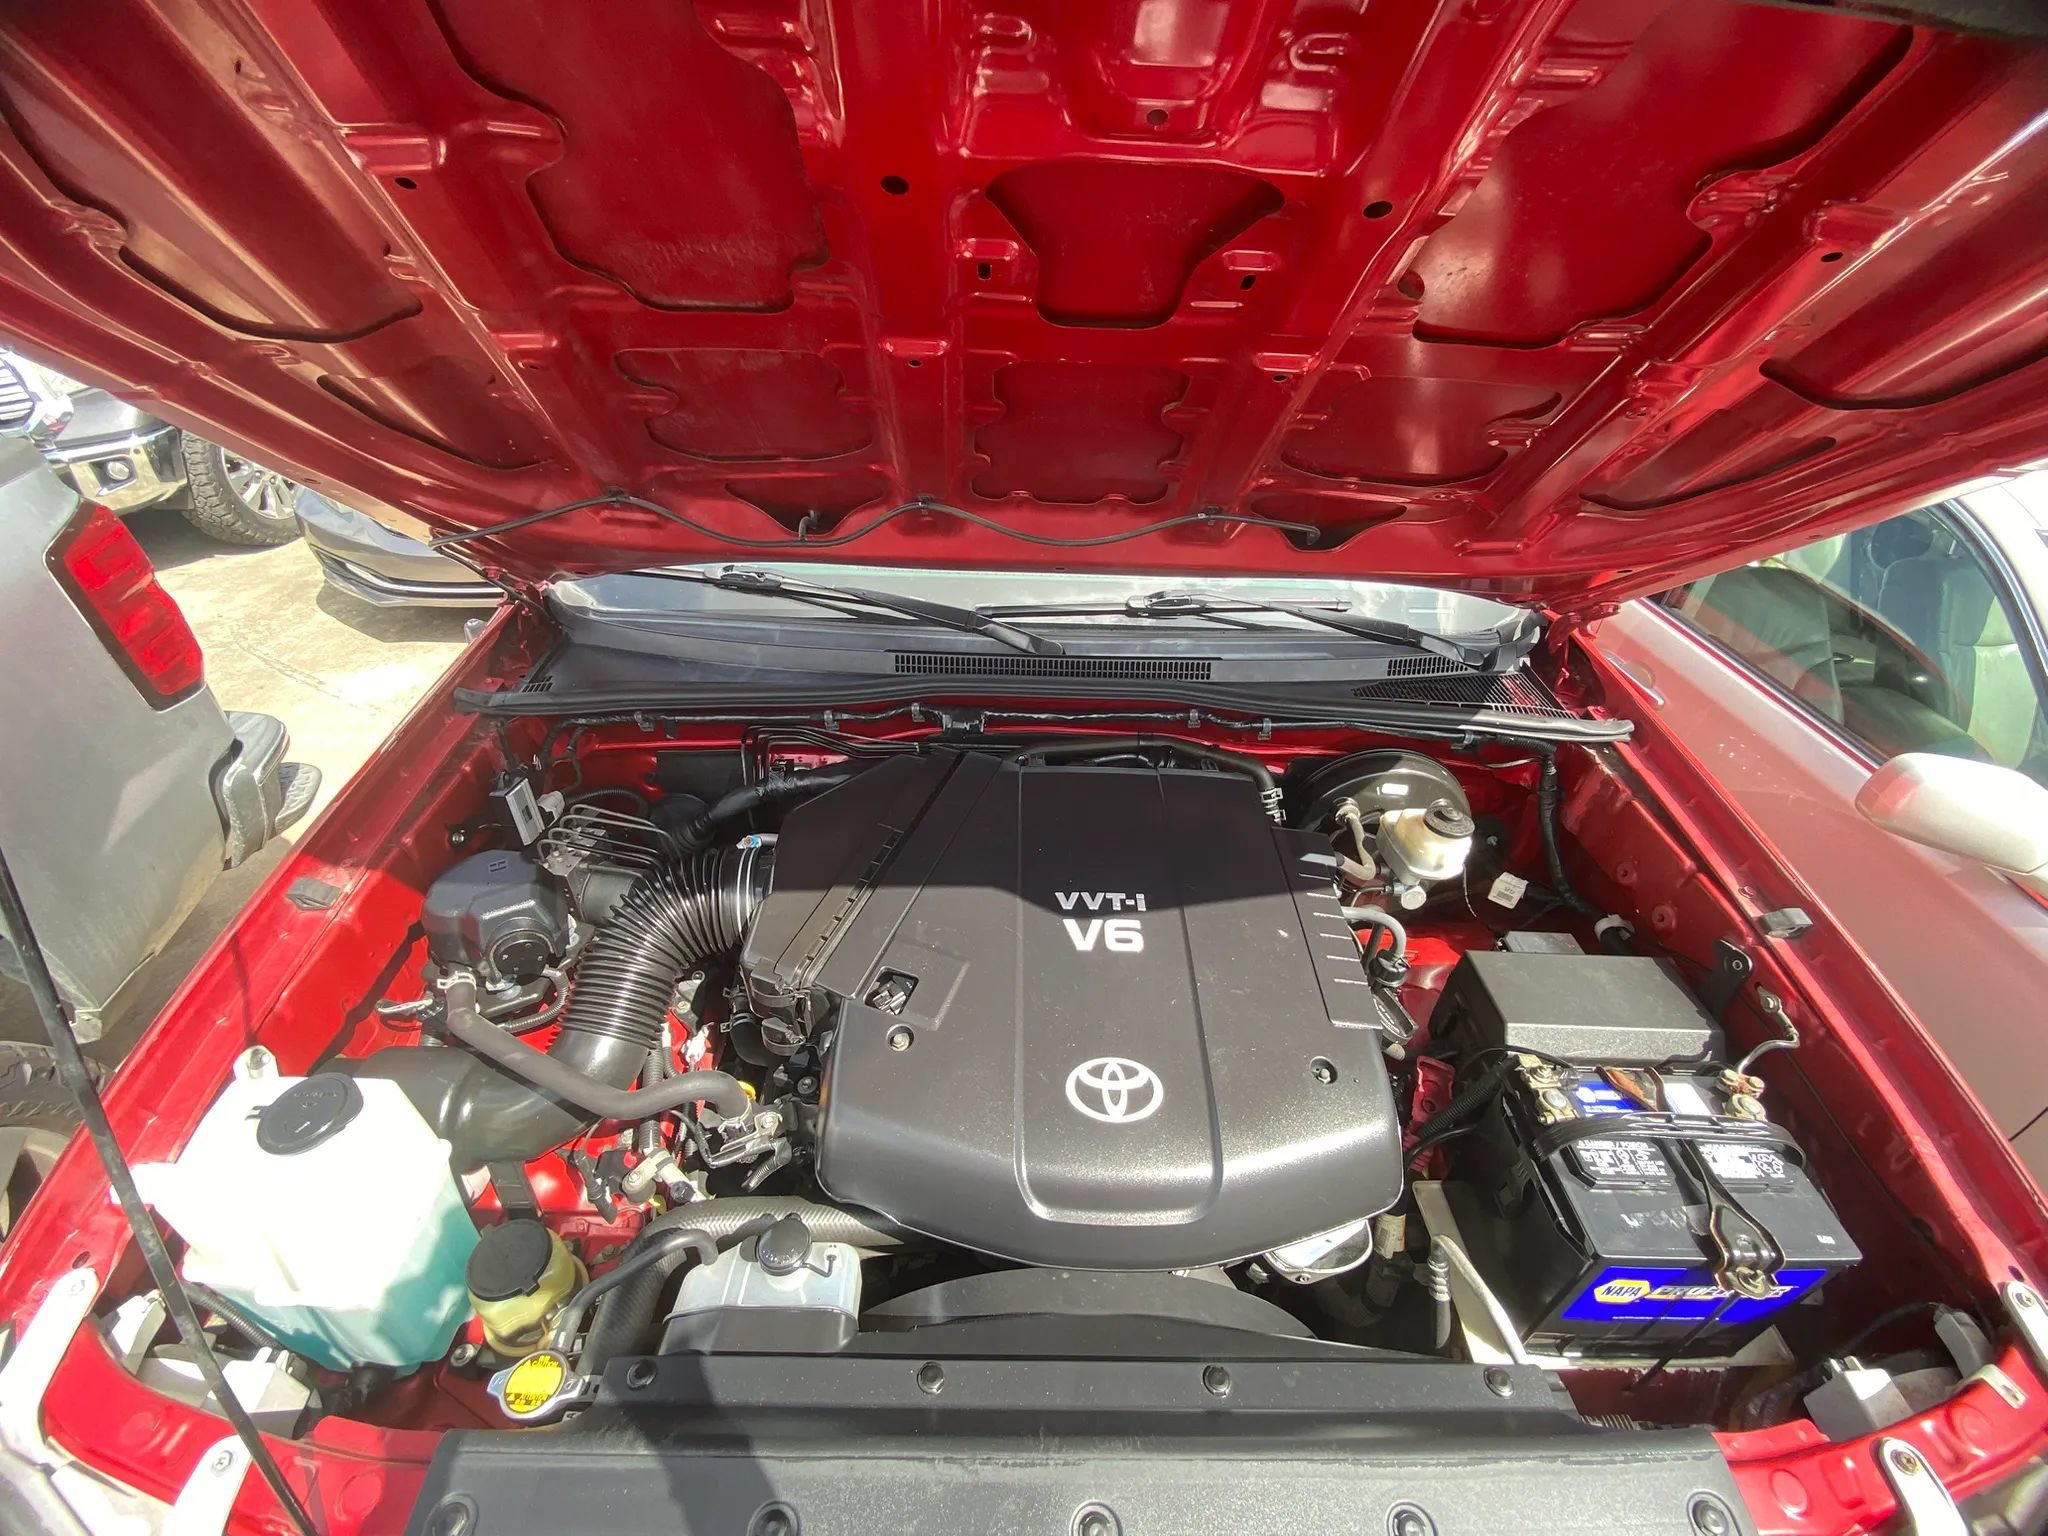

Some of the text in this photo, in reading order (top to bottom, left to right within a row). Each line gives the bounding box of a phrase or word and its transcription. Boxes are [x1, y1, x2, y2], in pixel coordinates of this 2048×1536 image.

[1054, 891, 1147, 912] VVT-i
[1062, 918, 1145, 952] V6
[1600, 1285, 1643, 1297] NAPA
